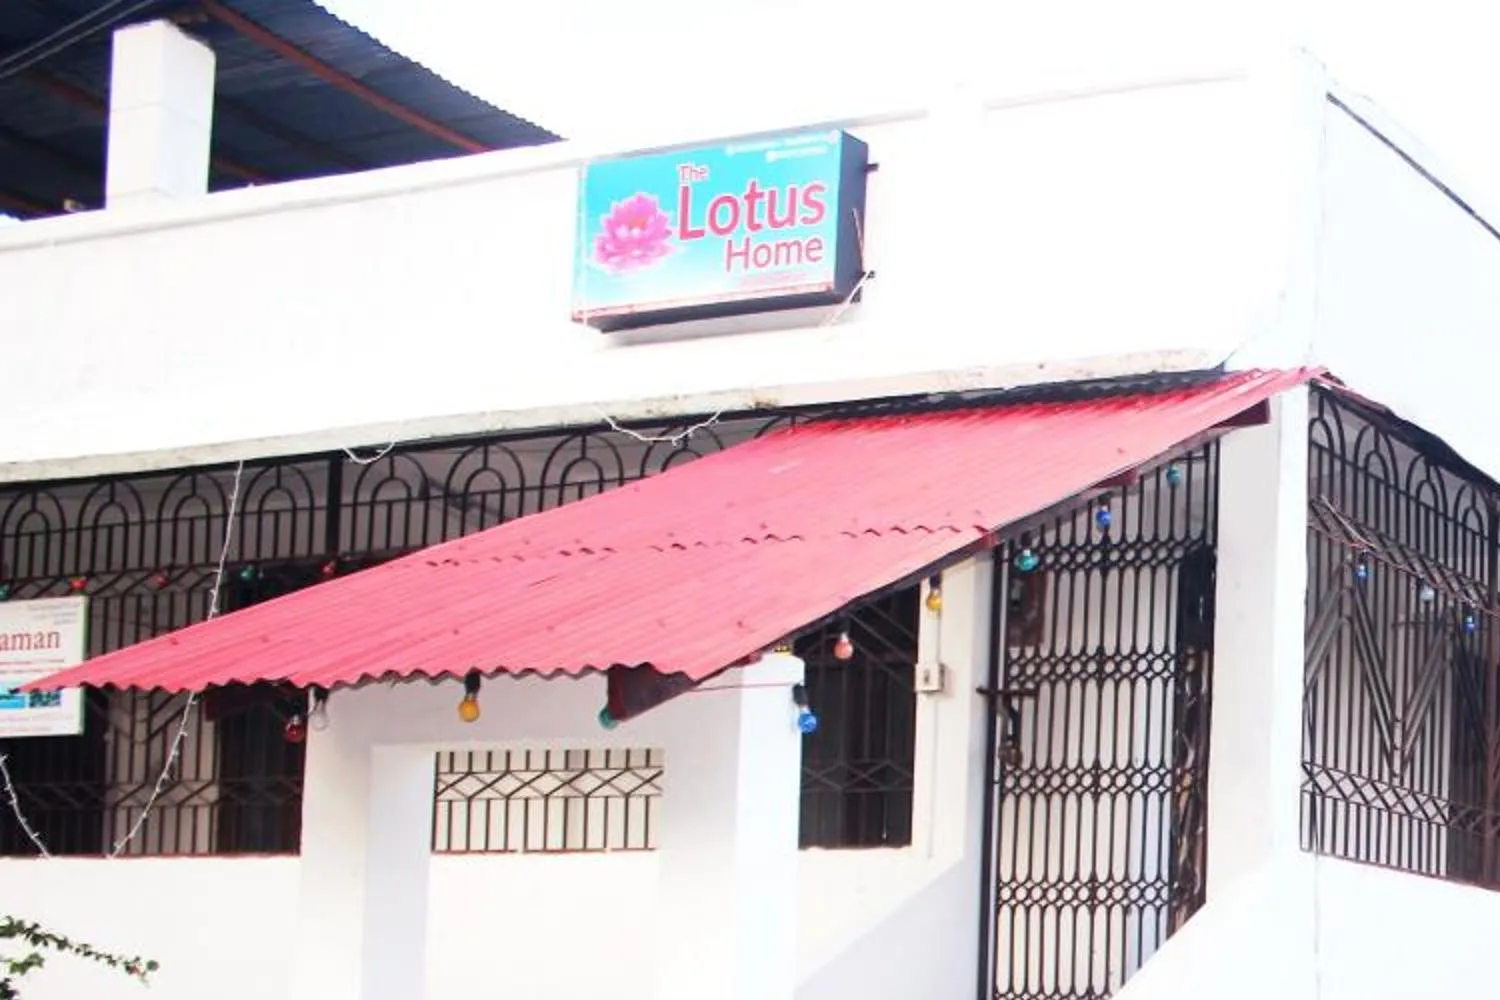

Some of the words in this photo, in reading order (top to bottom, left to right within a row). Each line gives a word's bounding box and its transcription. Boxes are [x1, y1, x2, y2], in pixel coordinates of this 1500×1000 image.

[680, 164, 708, 181] The
[678, 180, 826, 240] Lotus
[725, 236, 824, 272] Home
